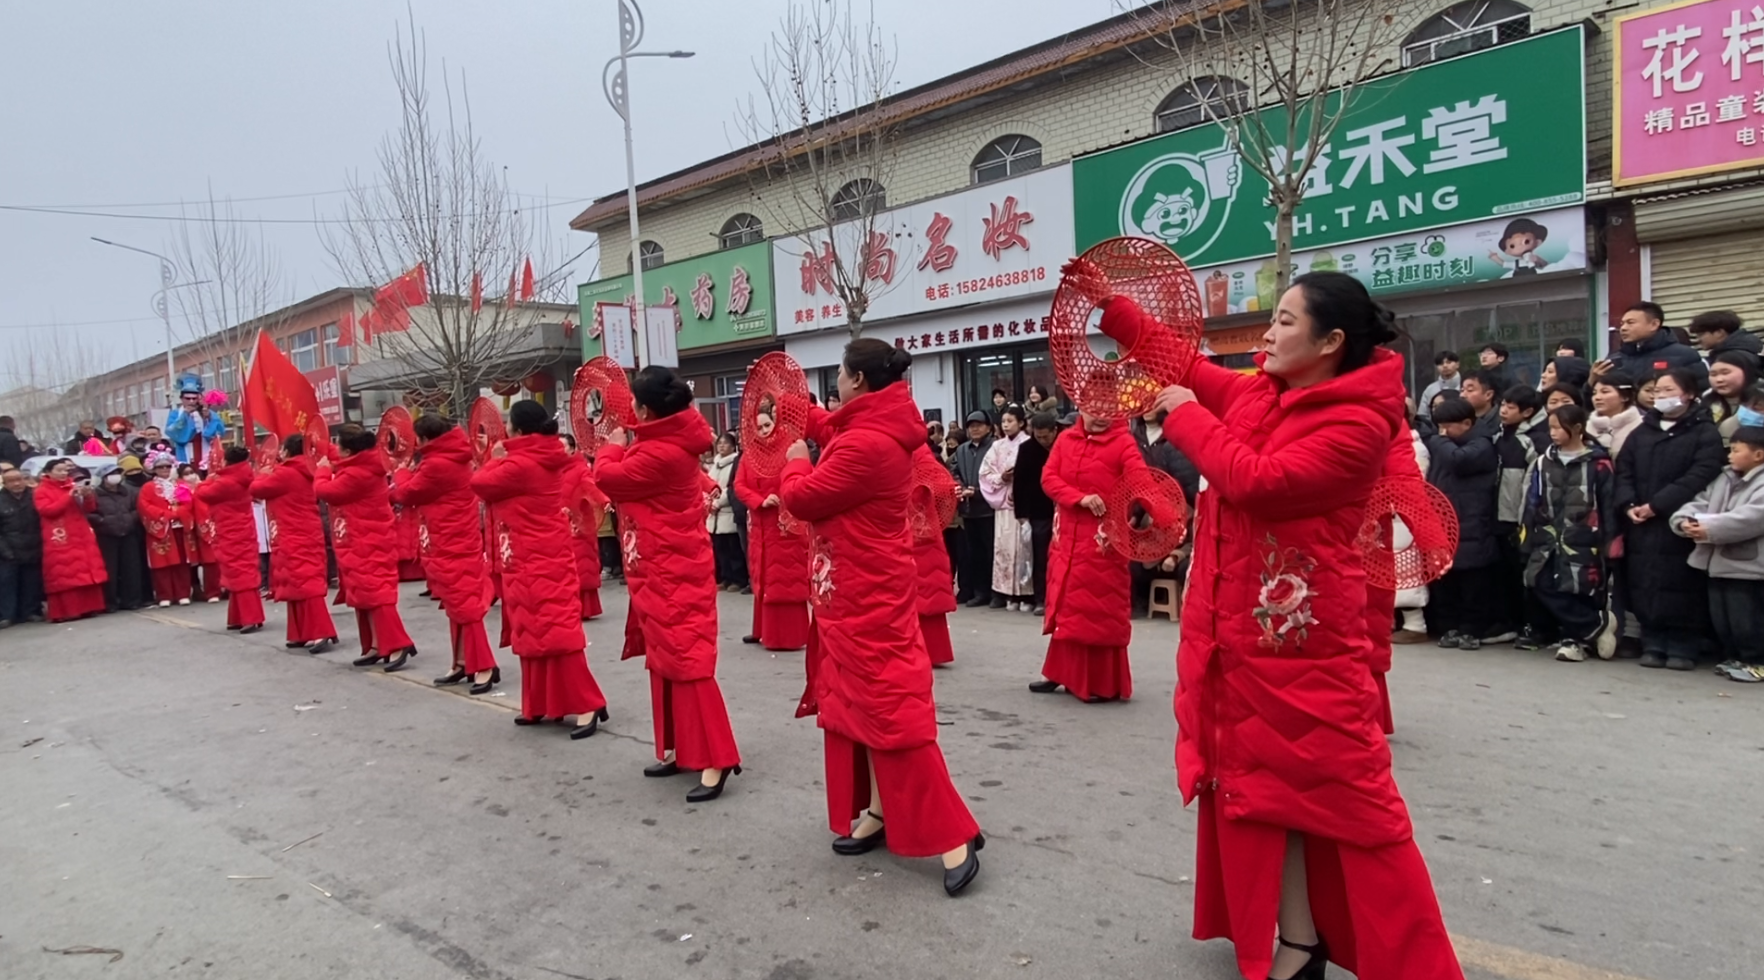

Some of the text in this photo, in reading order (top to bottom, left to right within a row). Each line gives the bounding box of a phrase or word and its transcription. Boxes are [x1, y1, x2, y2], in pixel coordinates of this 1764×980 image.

[1641, 5, 1764, 98] 花样
[1736, 124, 1764, 146] 电
[1263, 186, 1459, 241] YH.TANG
[799, 195, 1034, 297] 时尚名妆
[1371, 242, 1418, 267] 分享
[925, 266, 1046, 301] 电话:15824638818
[1371, 256, 1475, 289] 益趣时刻
[794, 303, 843, 324] 美容 养生
